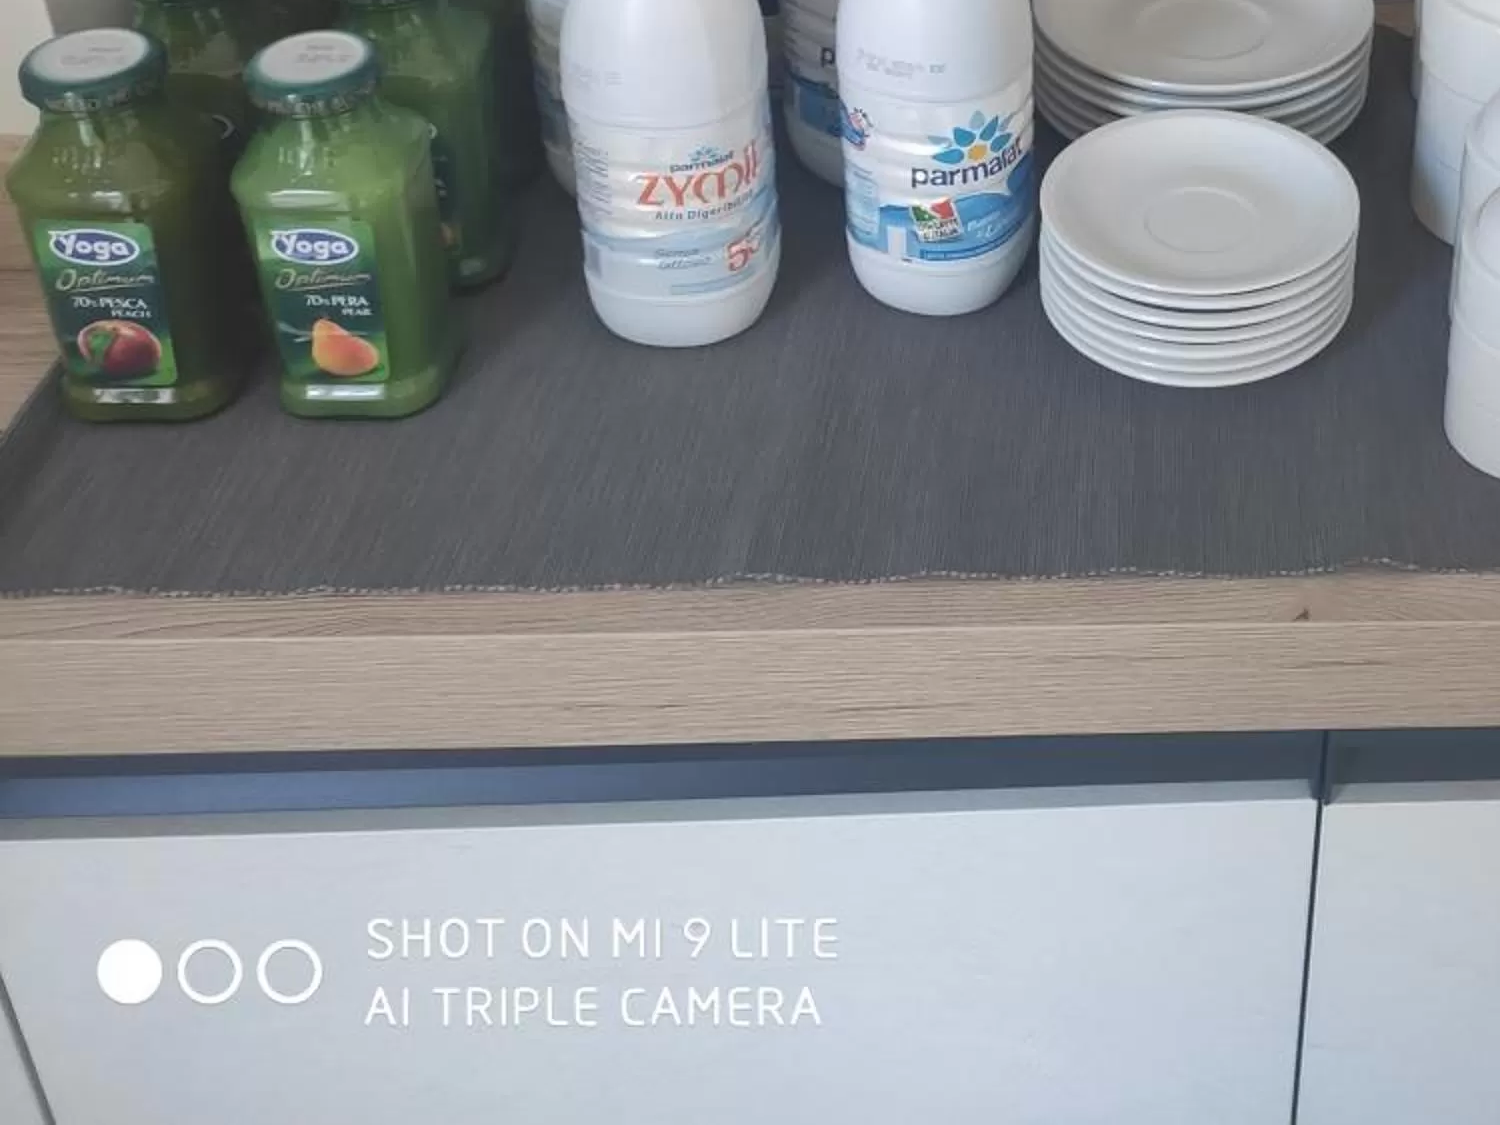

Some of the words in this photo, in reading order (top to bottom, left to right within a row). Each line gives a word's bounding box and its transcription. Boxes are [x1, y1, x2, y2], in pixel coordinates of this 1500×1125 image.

[669, 150, 735, 173] parmalat
[911, 137, 1023, 189] parmalat
[56, 233, 131, 262] Yoga
[277, 233, 350, 261] Yoga
[331, 295, 369, 307] PERA
